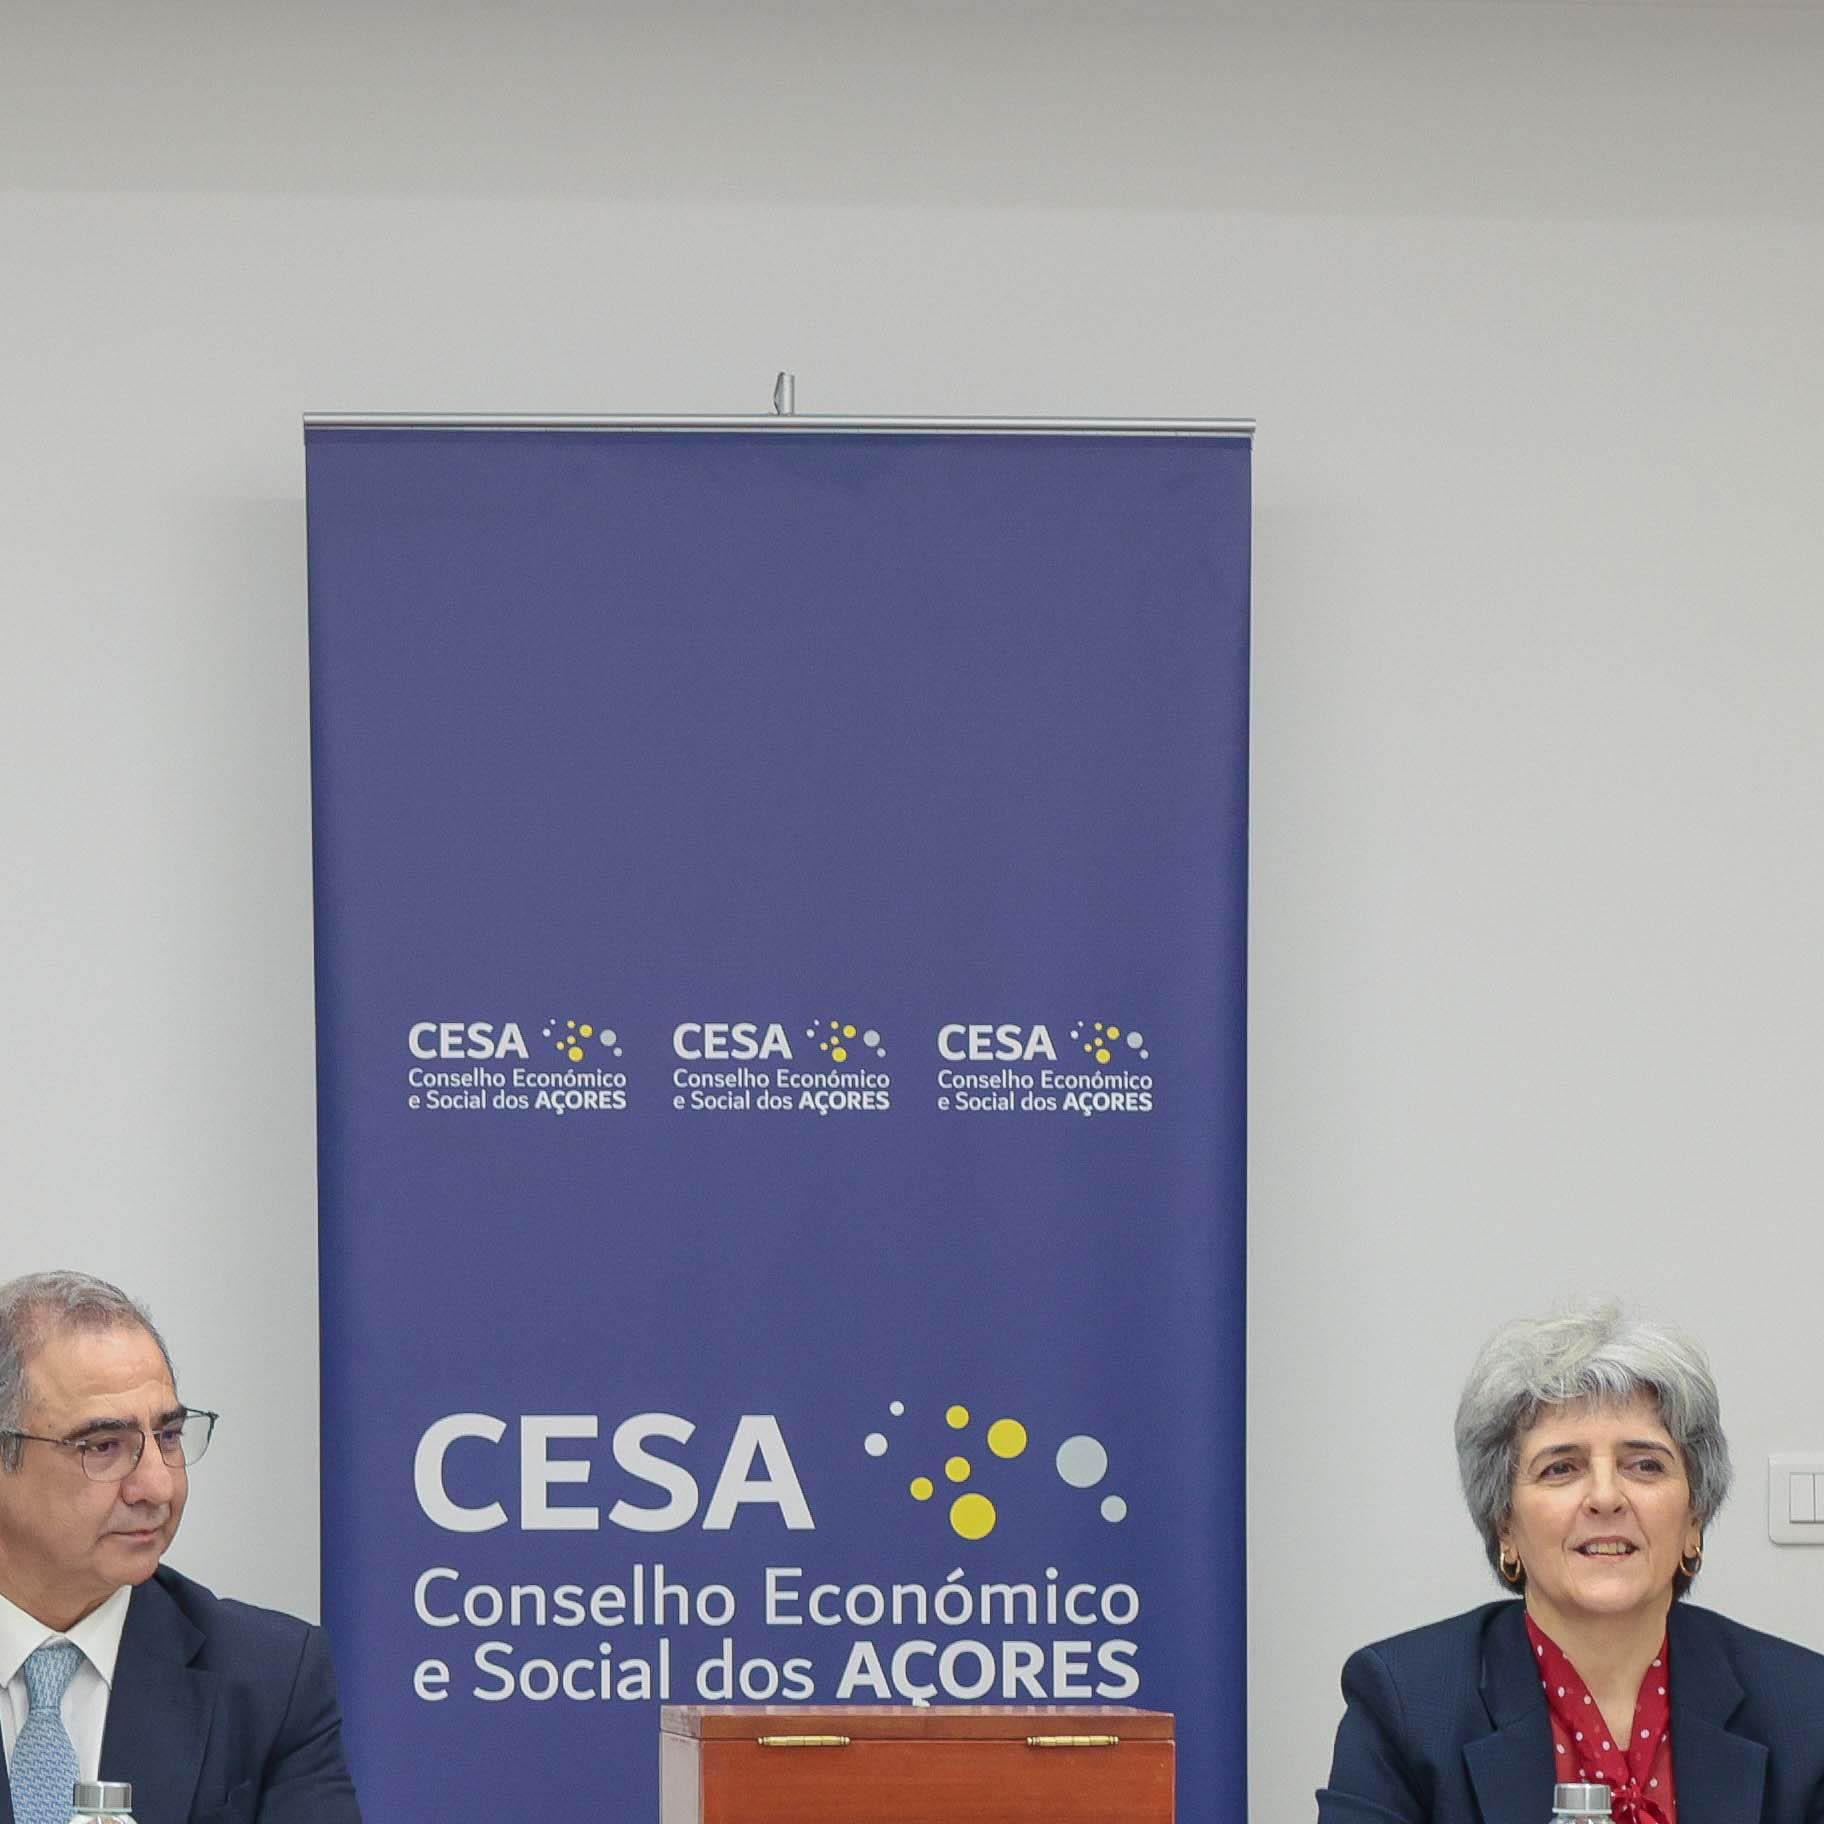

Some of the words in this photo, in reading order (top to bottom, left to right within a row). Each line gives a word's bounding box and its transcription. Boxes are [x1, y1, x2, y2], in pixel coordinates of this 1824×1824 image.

[408, 1022, 530, 1060] CESA
[673, 1022, 793, 1060] CESA
[937, 1023, 1058, 1061] CESA
[408, 1067, 506, 1088] Conselho
[512, 1068, 627, 1089] Económico
[673, 1067, 770, 1089] Conselho
[776, 1068, 890, 1089] Económico
[937, 1068, 1034, 1090] Conselho
[1041, 1069, 1153, 1090] Económico
[408, 1094, 421, 1110] e
[426, 1088, 487, 1110] Social
[492, 1088, 530, 1110] dos
[534, 1089, 627, 1115] AÇORES
[672, 1095, 686, 1110] e
[690, 1089, 751, 1110] Social
[756, 1089, 793, 1110] dos
[798, 1090, 890, 1116] AÇORES
[937, 1096, 950, 1111] e
[955, 1090, 1015, 1111] Social
[1020, 1090, 1058, 1111] dos
[1062, 1091, 1153, 1117] AÇORES
[413, 1411, 817, 1533] CESA
[414, 1563, 735, 1627] Conselho
[765, 1566, 1140, 1627] Económico
[413, 1659, 450, 1701] e
[473, 1637, 670, 1701] Social
[696, 1637, 815, 1701] dos
[836, 1639, 1141, 1706] AÇORES
